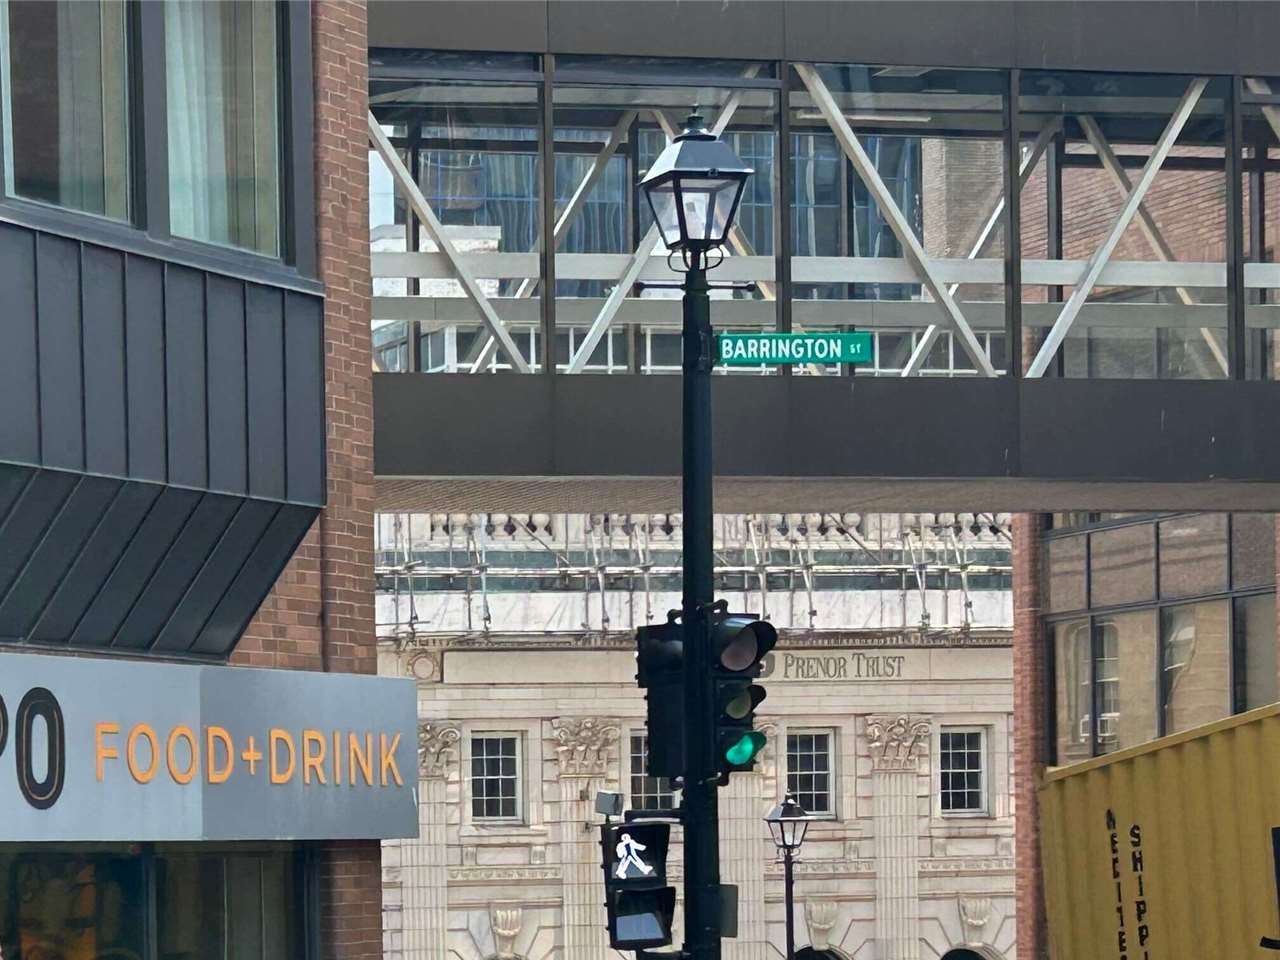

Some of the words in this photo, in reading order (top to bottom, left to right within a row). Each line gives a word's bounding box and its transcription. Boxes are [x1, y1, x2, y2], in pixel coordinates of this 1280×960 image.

[721, 338, 842, 359] BARRINGTON
[783, 652, 847, 679] PRENOR
[852, 652, 905, 678] TRUST
[95, 721, 404, 787] FOOD+DRINK
